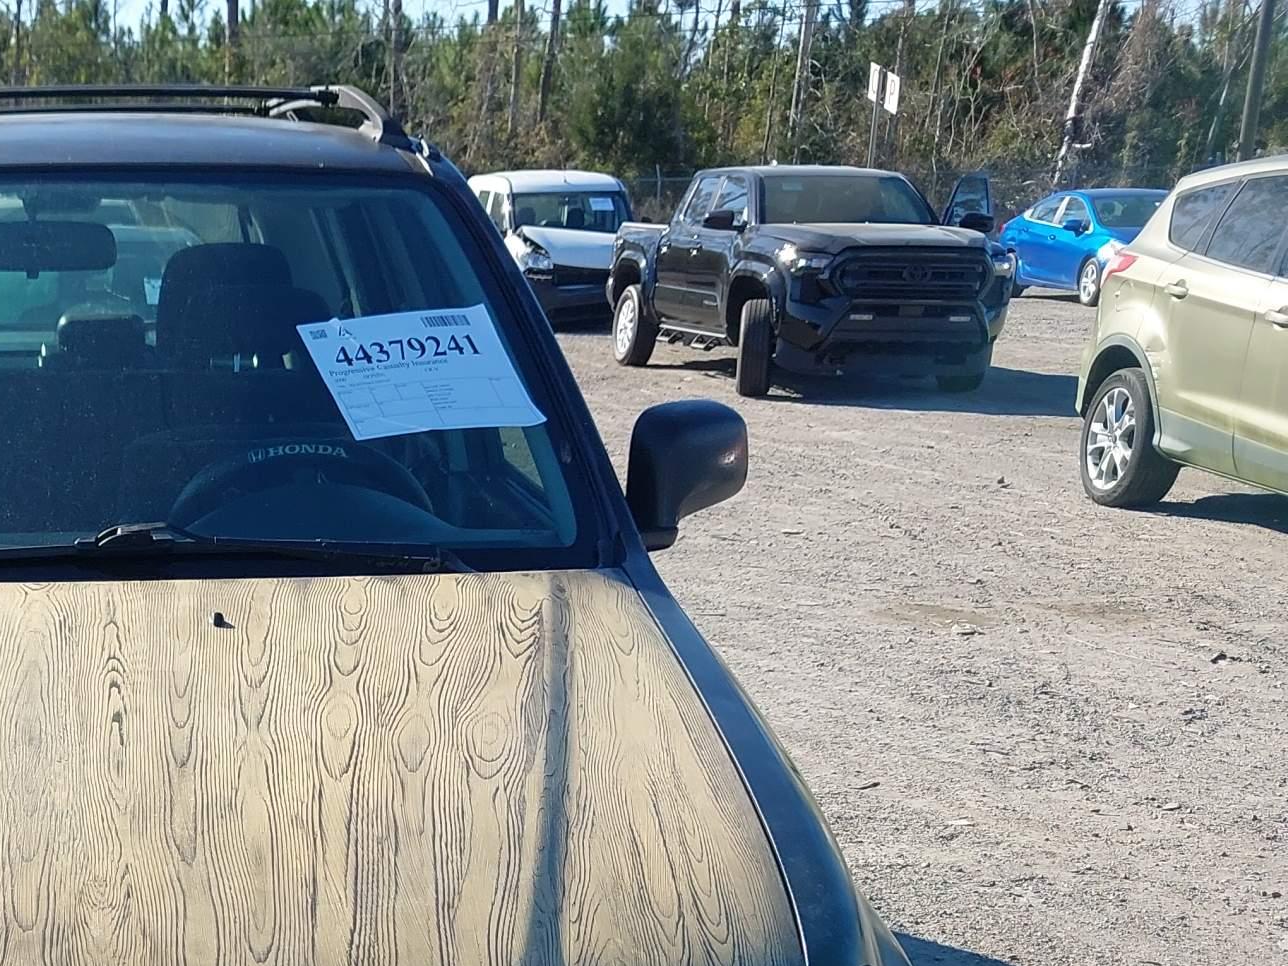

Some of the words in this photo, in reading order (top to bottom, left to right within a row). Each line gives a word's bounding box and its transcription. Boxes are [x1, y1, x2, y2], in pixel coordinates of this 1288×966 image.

[335, 334, 481, 367] 44379241
[328, 366, 375, 377] Progressive
[267, 443, 349, 458] HONDA
